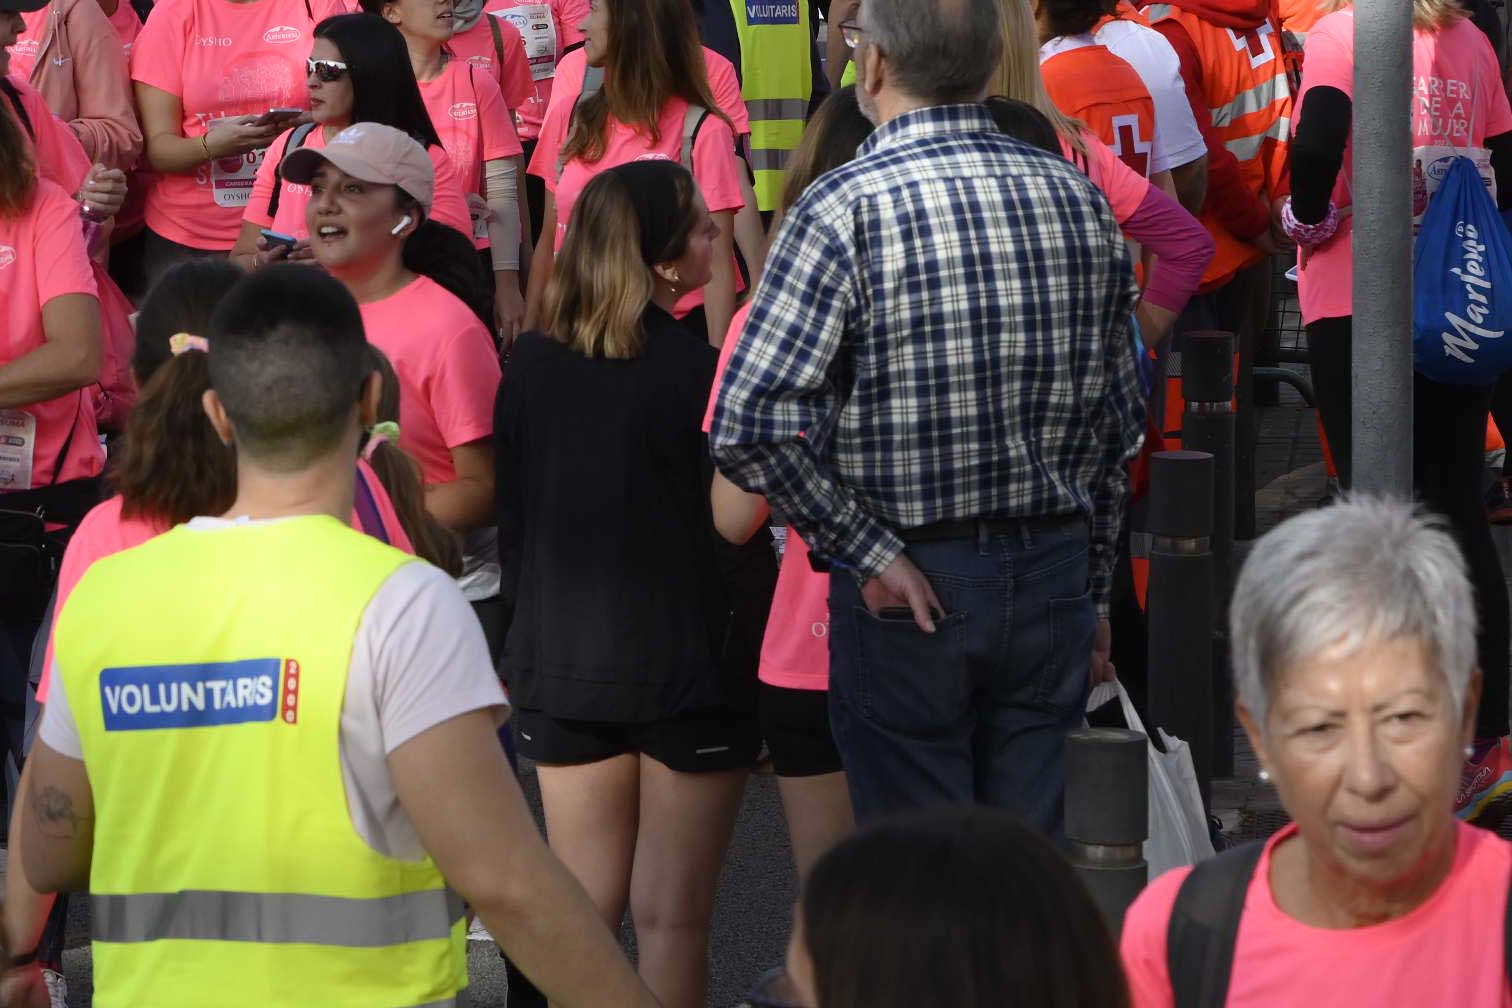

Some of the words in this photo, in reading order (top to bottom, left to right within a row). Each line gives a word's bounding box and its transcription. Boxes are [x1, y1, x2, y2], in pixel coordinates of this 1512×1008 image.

[1419, 97, 1441, 115] DE
[247, 151, 265, 164] 01
[104, 674, 274, 716] VOLUNTARIS
